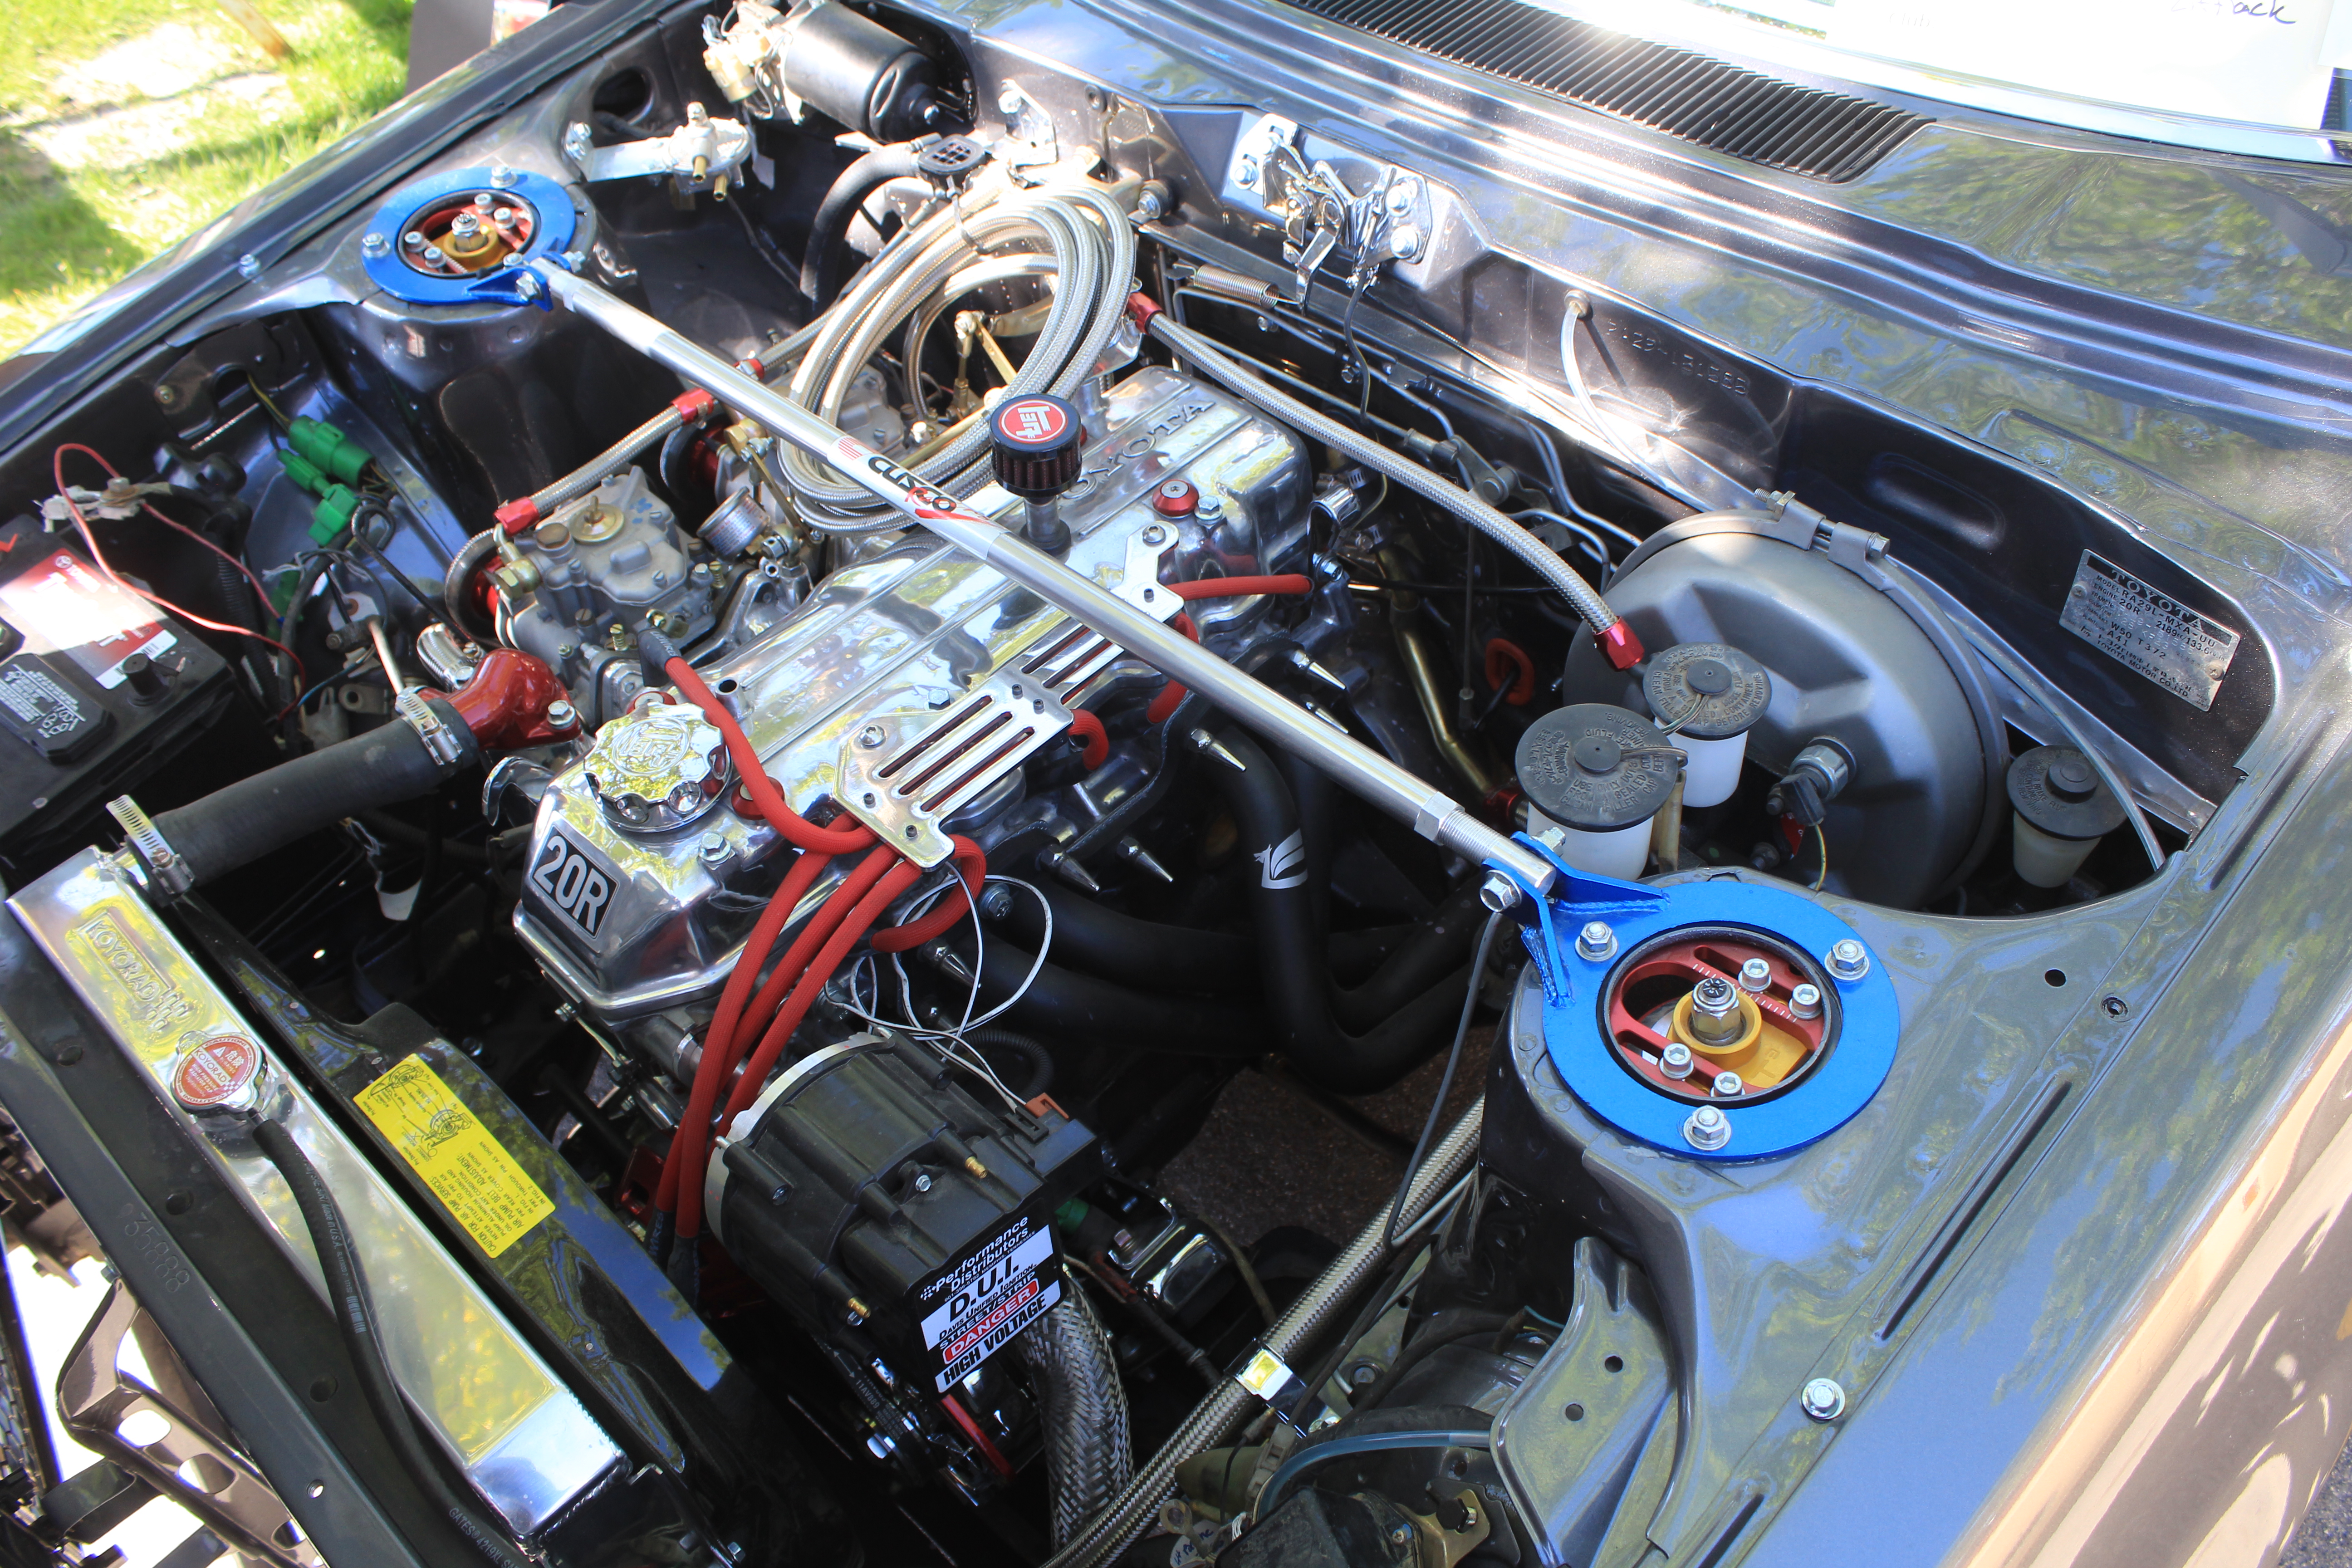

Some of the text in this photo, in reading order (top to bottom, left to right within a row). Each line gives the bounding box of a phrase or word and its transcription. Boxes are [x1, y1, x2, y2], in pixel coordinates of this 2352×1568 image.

[1063, 399, 1215, 499] OYOTA
[2093, 582, 2118, 601] ENGINE
[2118, 597, 2141, 616] 20R
[2095, 574, 2121, 593] MODEL
[2121, 588, 2216, 649] RA29L-MXA-UU
[2108, 568, 2207, 632] TOYOTA
[2109, 620, 2133, 640] W50
[2136, 636, 2167, 661] T372
[2096, 639, 2126, 661] TOYOTA
[2128, 658, 2156, 679] MOTOR
[1662, 673, 1672, 691] FROM
[1652, 671, 1662, 695] CLEAN
[1658, 697, 1683, 719] FILLE
[1716, 709, 1749, 727] BEFORE
[1573, 779, 1593, 791] USE
[1585, 729, 1615, 739] FLUID
[1614, 774, 1647, 800] SEALED
[1642, 779, 1658, 795] CAP
[2018, 788, 2042, 815] REMOVING
[2024, 774, 2040, 803] CONTAINER
[2033, 784, 2048, 802] BRAKE
[533, 835, 609, 932] 20R
[86, 919, 162, 1002] KOYORAD
[206, 1038, 247, 1048] CAUTION!
[188, 1068, 206, 1087] RADIATOR
[204, 1084, 213, 1093] CAP
[191, 1063, 201, 1073] HIGH
[200, 1071, 219, 1091] PRESSURE
[195, 1049, 227, 1082] KOYORAD
[361, 1100, 372, 1112] Direction
[401, 1146, 416, 1160] Direction
[416, 1147, 430, 1162] CORRECT
[466, 1151, 482, 1167] SHOWN
[478, 1141, 493, 1156] SHOWN
[486, 1174, 504, 1192] COVER
[498, 1164, 508, 1173] PIN
[455, 1152, 524, 1230] AIR PUMP BELT ADJUSTMENT:
[456, 1169, 513, 1232] OIL UNDER ANY CONDITION.
[502, 1192, 516, 1206] REAR
[507, 1174, 529, 1196] THROUGH
[439, 1173, 499, 1240] NEVER ATTEMPT TO PRY AIR
[446, 1168, 507, 1236] PUMP ALUMINUM HOUSING AND
[447, 1197, 462, 1212] PUMP
[459, 1210, 470, 1221] AIR
[515, 1206, 525, 1217] PRY
[528, 1197, 539, 1208] PRY
[321, 1203, 333, 1221] Made
[329, 1227, 344, 1250] U.S.A.
[467, 1220, 480, 1233] FOR
[476, 1231, 497, 1252] CAUTION
[1007, 1230, 1035, 1254] TENNESSEE
[125, 1215, 192, 1294] 35888
[934, 1213, 1029, 1293] Performance
[950, 1225, 1029, 1293] Distributors
[946, 1251, 1019, 1323] D.U.I.
[938, 1289, 999, 1341] DAVIS UNIFIED
[939, 1269, 1036, 1351] STREET/STRIP
[950, 1286, 1031, 1357] DANGER
[943, 1293, 1046, 1386] HIGH VOLTAGE
[474, 1533, 506, 1566] 4219XL
